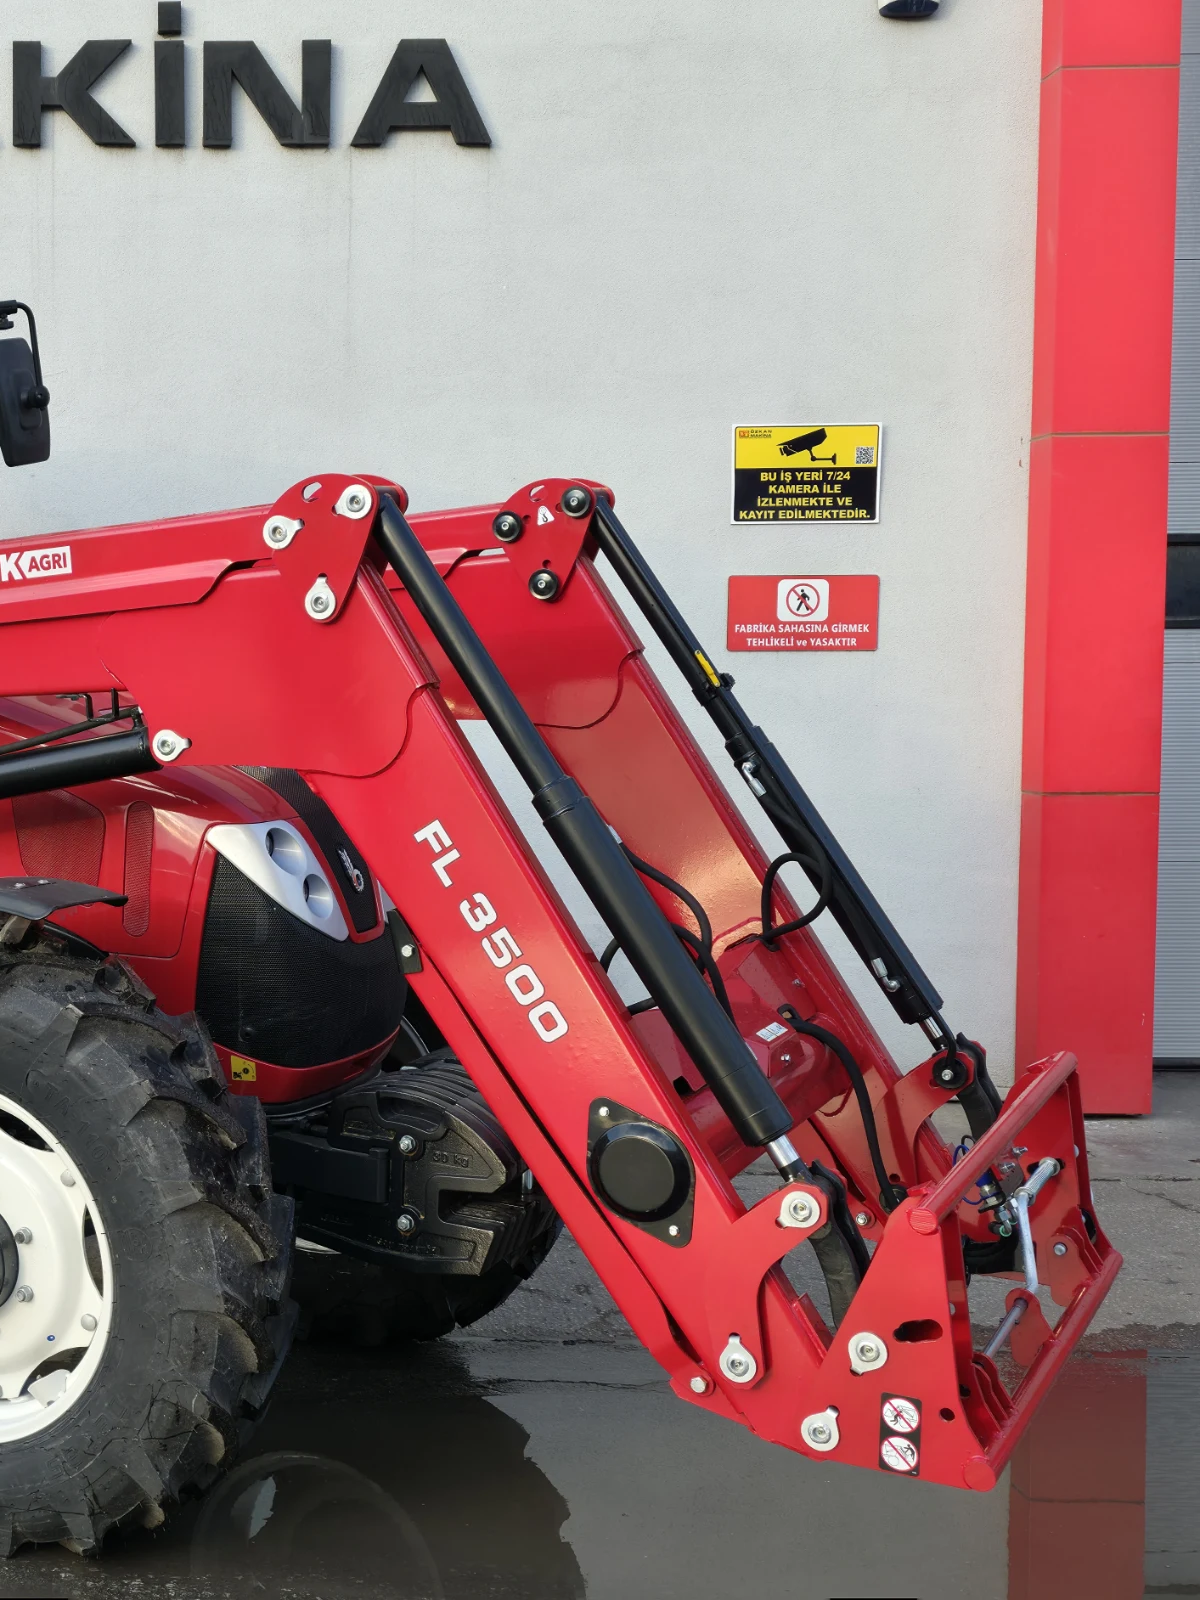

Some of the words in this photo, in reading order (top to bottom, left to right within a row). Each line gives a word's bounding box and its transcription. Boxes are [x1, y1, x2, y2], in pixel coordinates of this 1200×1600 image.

[760, 472, 777, 481] BU
[780, 470, 792, 483] İŞ
[795, 470, 823, 481] YERİ
[827, 471, 851, 481] 7/24
[769, 484, 820, 494] KAMERA
[823, 482, 842, 494] İLE
[757, 495, 834, 507] İZLENMEKTE
[837, 497, 853, 506] VE
[739, 510, 776, 520] KAYIT
[778, 508, 871, 519] EDİLMEKTEDİR.
[28, 552, 68, 573] AGRI
[734, 622, 776, 633] FABRİKA
[778, 624, 829, 633] SAHASINA
[831, 622, 870, 633] GİRMEK
[746, 636, 795, 647] TEHLİKELİ
[796, 639, 807, 647] ve
[810, 637, 857, 647] YASAKTIR
[413, 819, 461, 888] FL
[459, 892, 569, 1043] 3500
